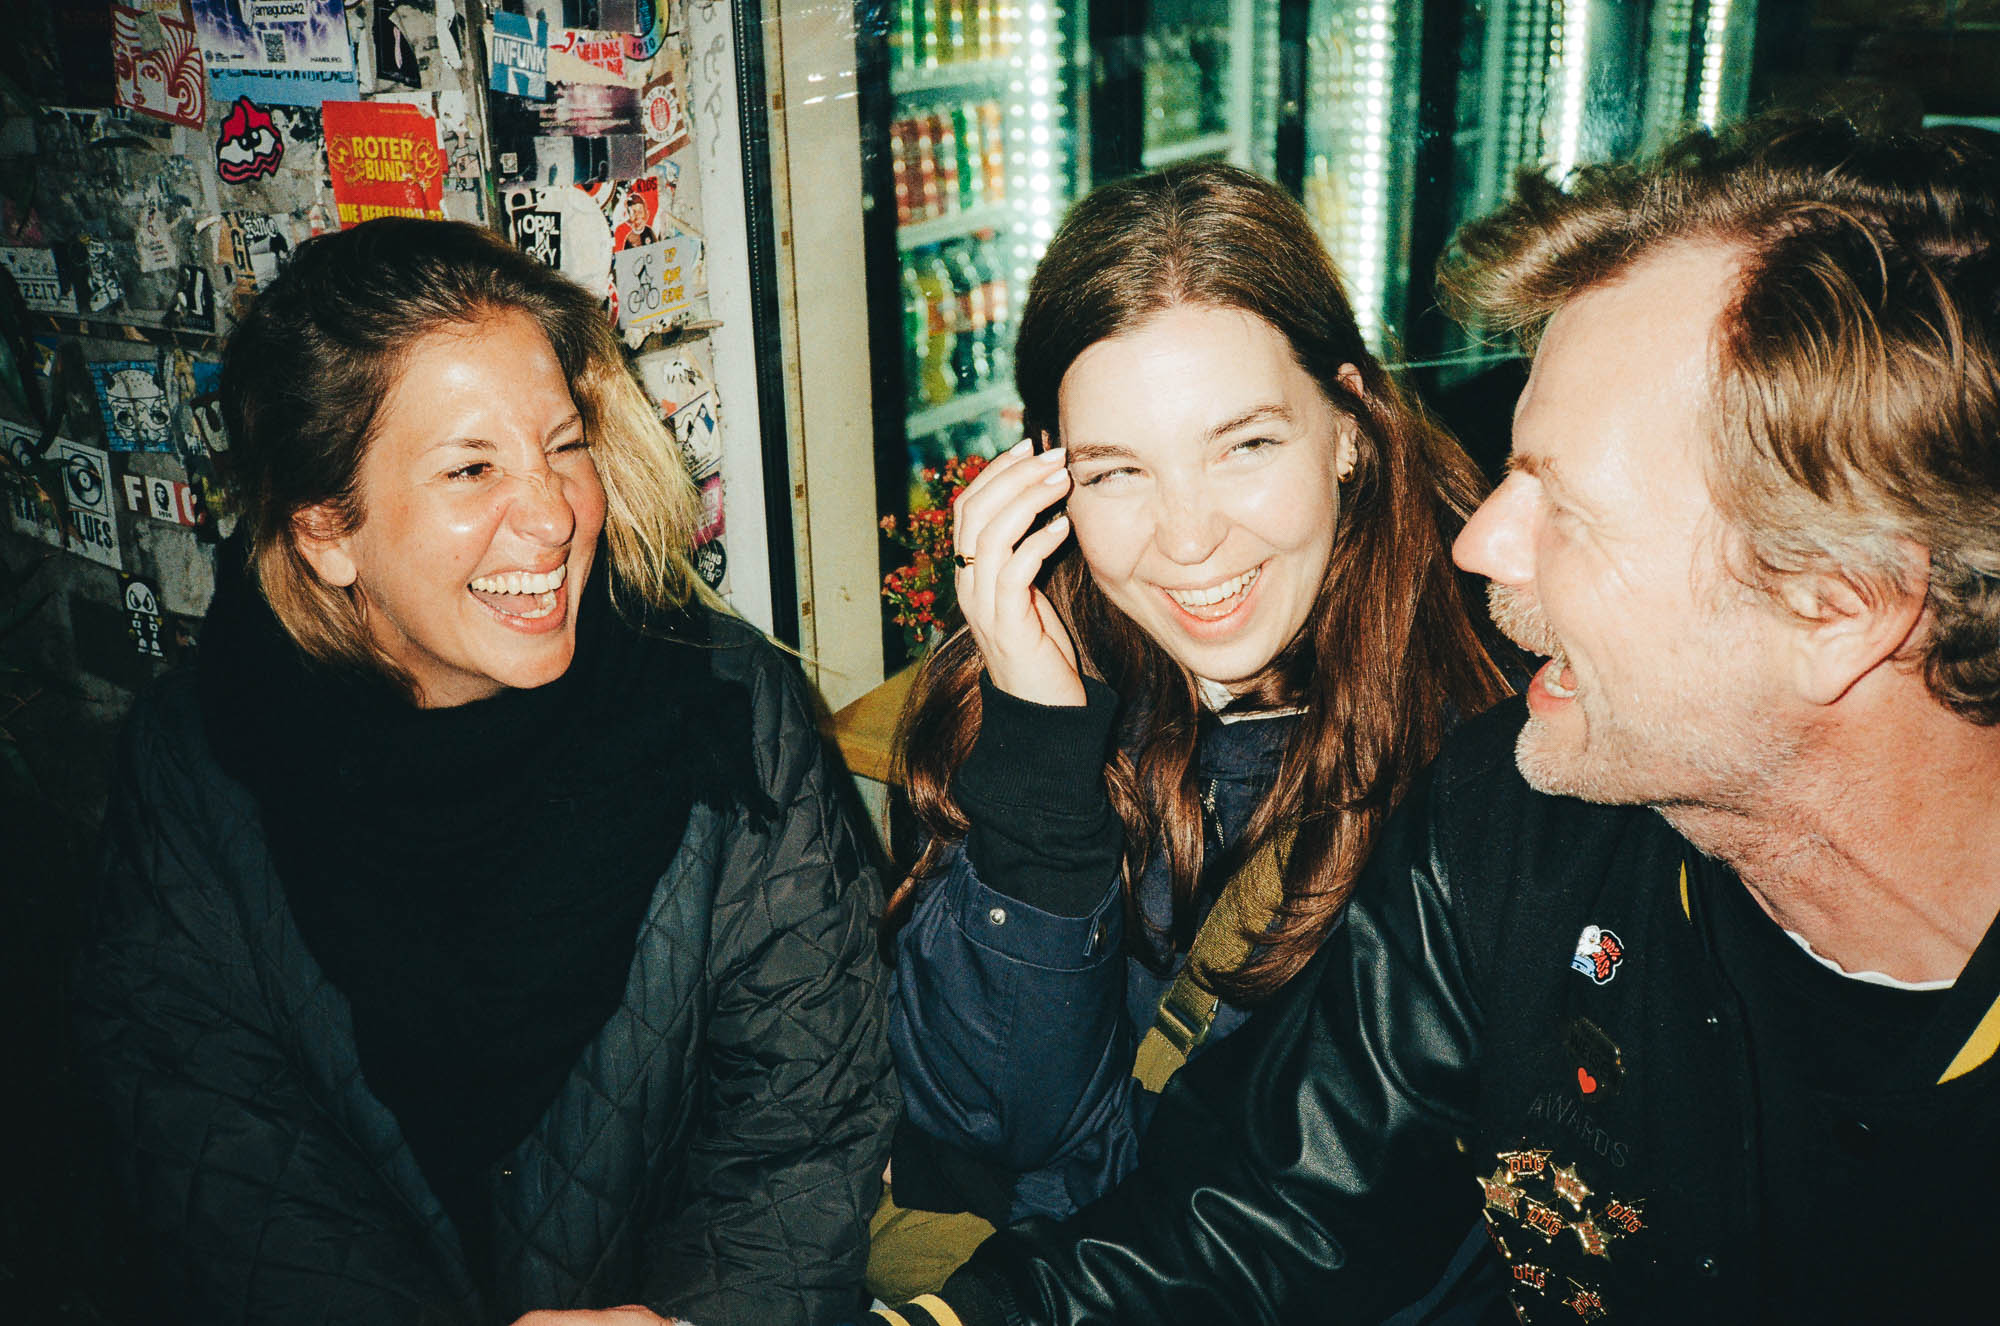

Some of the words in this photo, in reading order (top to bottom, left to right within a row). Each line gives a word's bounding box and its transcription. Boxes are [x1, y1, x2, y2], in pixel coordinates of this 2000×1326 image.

[494, 37, 546, 73] INFUNK
[632, 37, 656, 56] 1910
[352, 136, 413, 161] ROTER
[364, 158, 406, 182] BUND
[637, 177, 658, 192] KIDS
[338, 203, 360, 223] DIE
[522, 214, 560, 236] OPAL
[1600, 935, 1622, 962] 100%
[1592, 950, 1611, 979] BASS
[1510, 1154, 1545, 1174] DHG
[1526, 1206, 1562, 1237] DHG
[1607, 1203, 1643, 1234] DHG
[1513, 1264, 1545, 1288] DHG
[1570, 1292, 1601, 1316] DHG
